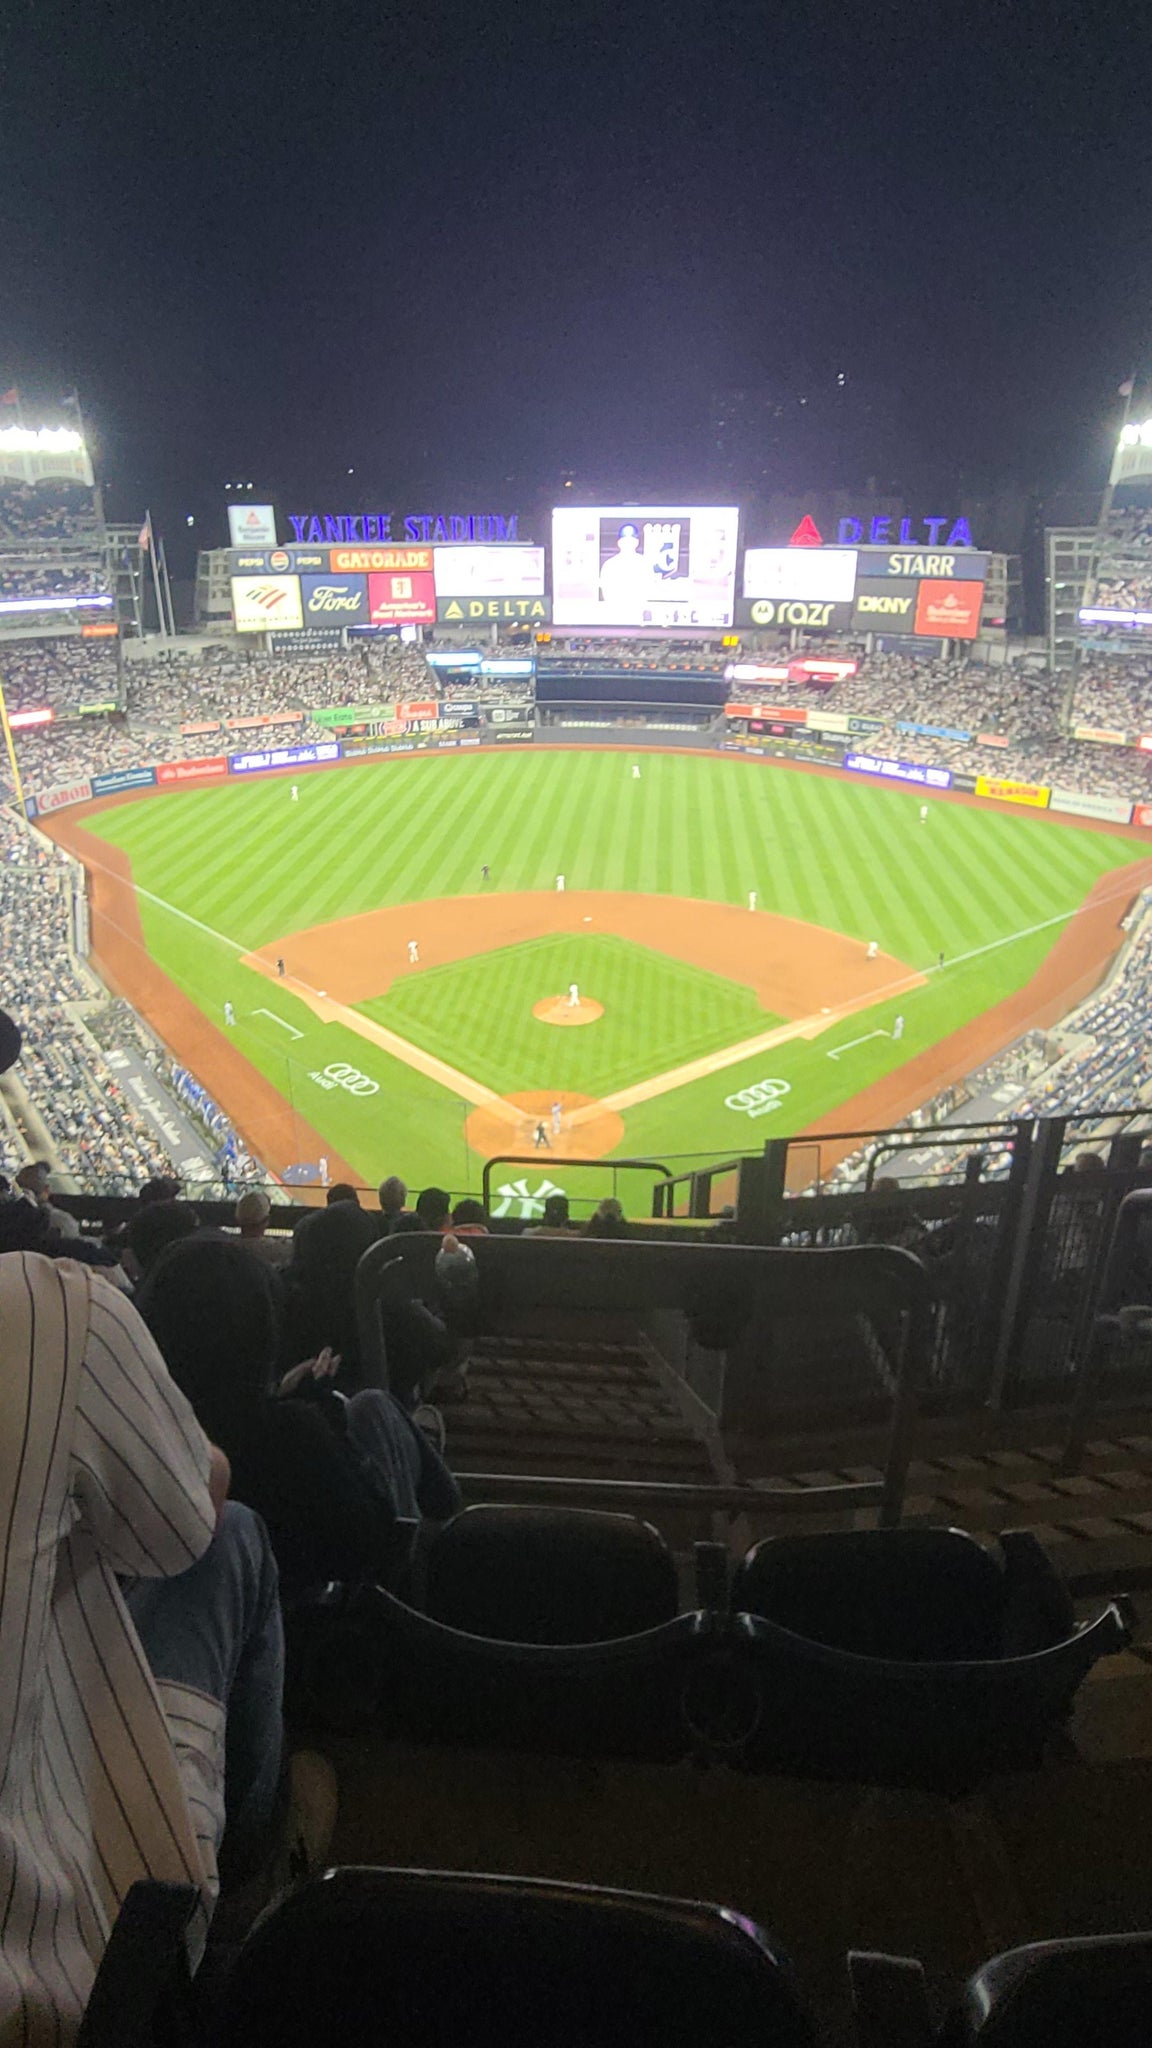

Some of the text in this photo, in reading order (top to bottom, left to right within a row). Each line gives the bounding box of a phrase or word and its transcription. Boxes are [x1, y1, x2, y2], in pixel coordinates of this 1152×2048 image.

[288, 514, 518, 543] YANKEE STADIUM
[837, 516, 973, 547] DELTA
[336, 552, 429, 569] GATORADE
[887, 554, 956, 577] STARR
[308, 586, 363, 612] Ford
[469, 600, 546, 617] DELTA
[857, 595, 913, 615] DKNY
[777, 603, 836, 627] razr
[38, 783, 90, 809] Canon
